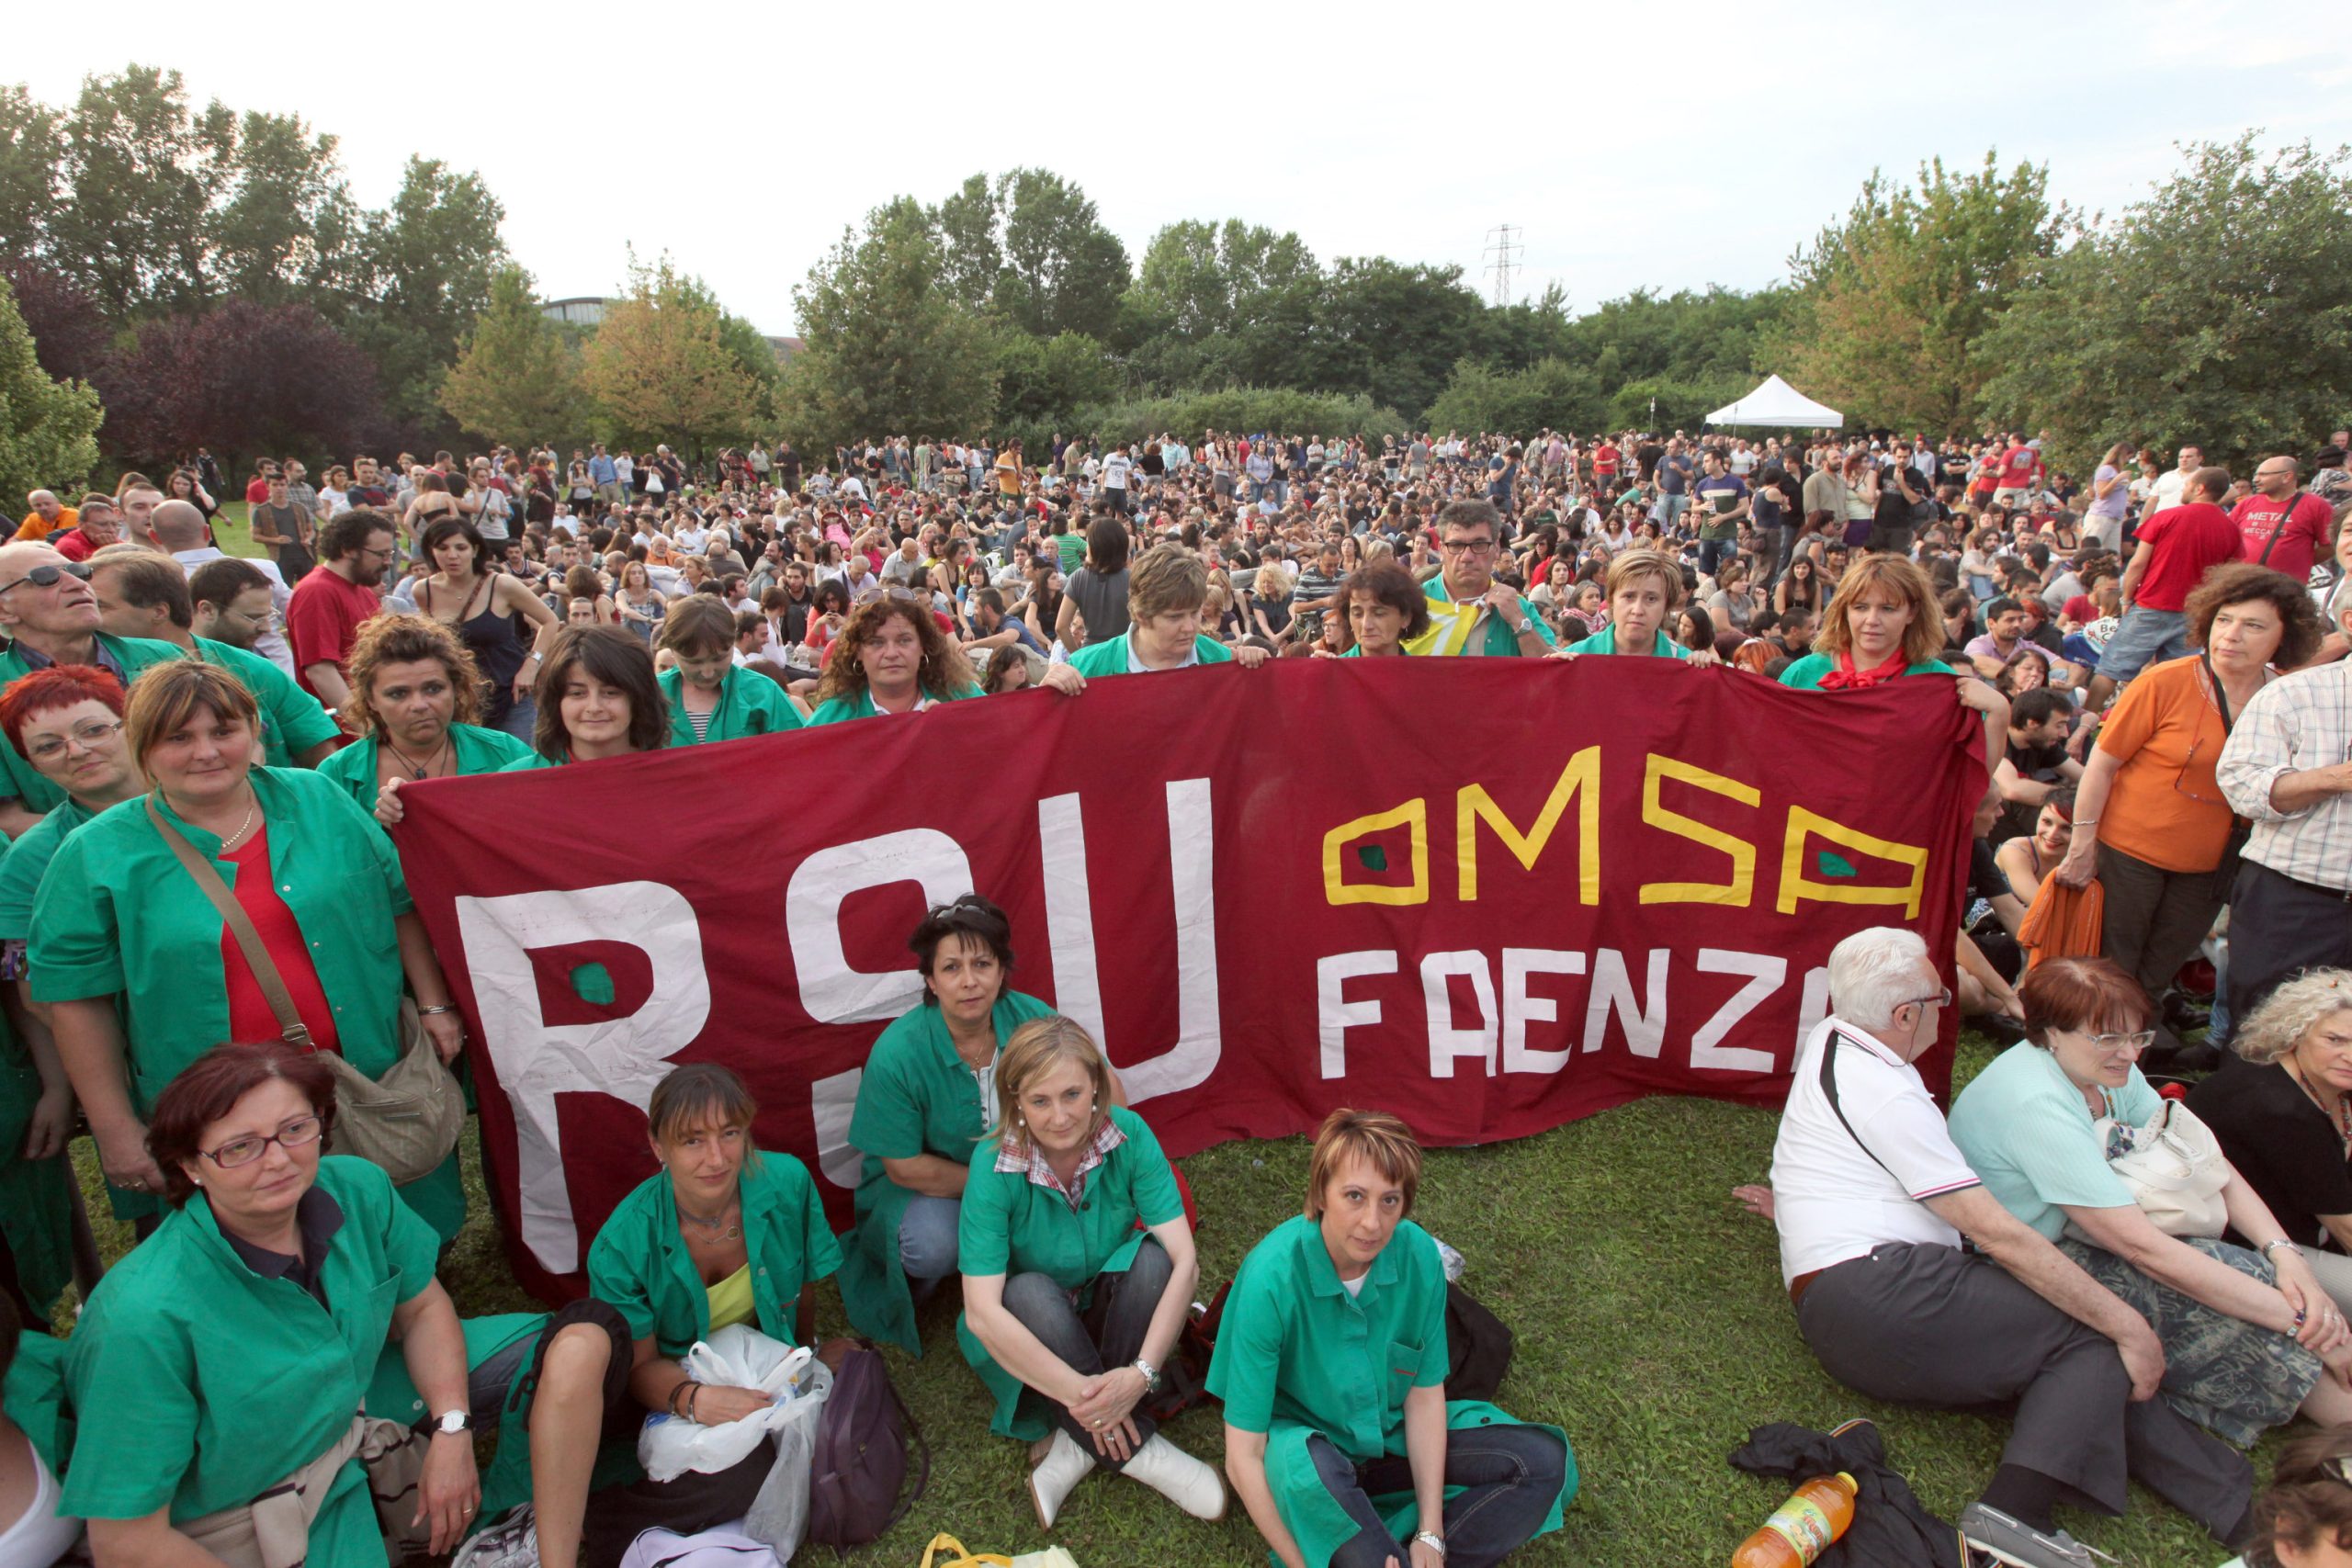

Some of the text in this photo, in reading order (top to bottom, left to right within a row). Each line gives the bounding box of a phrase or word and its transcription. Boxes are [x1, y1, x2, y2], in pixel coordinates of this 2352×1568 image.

[2244, 526, 2288, 536] MECCACI
[2246, 512, 2293, 523] METAL
[1323, 745, 1928, 920] OMSA
[455, 777, 1223, 1274] RSU
